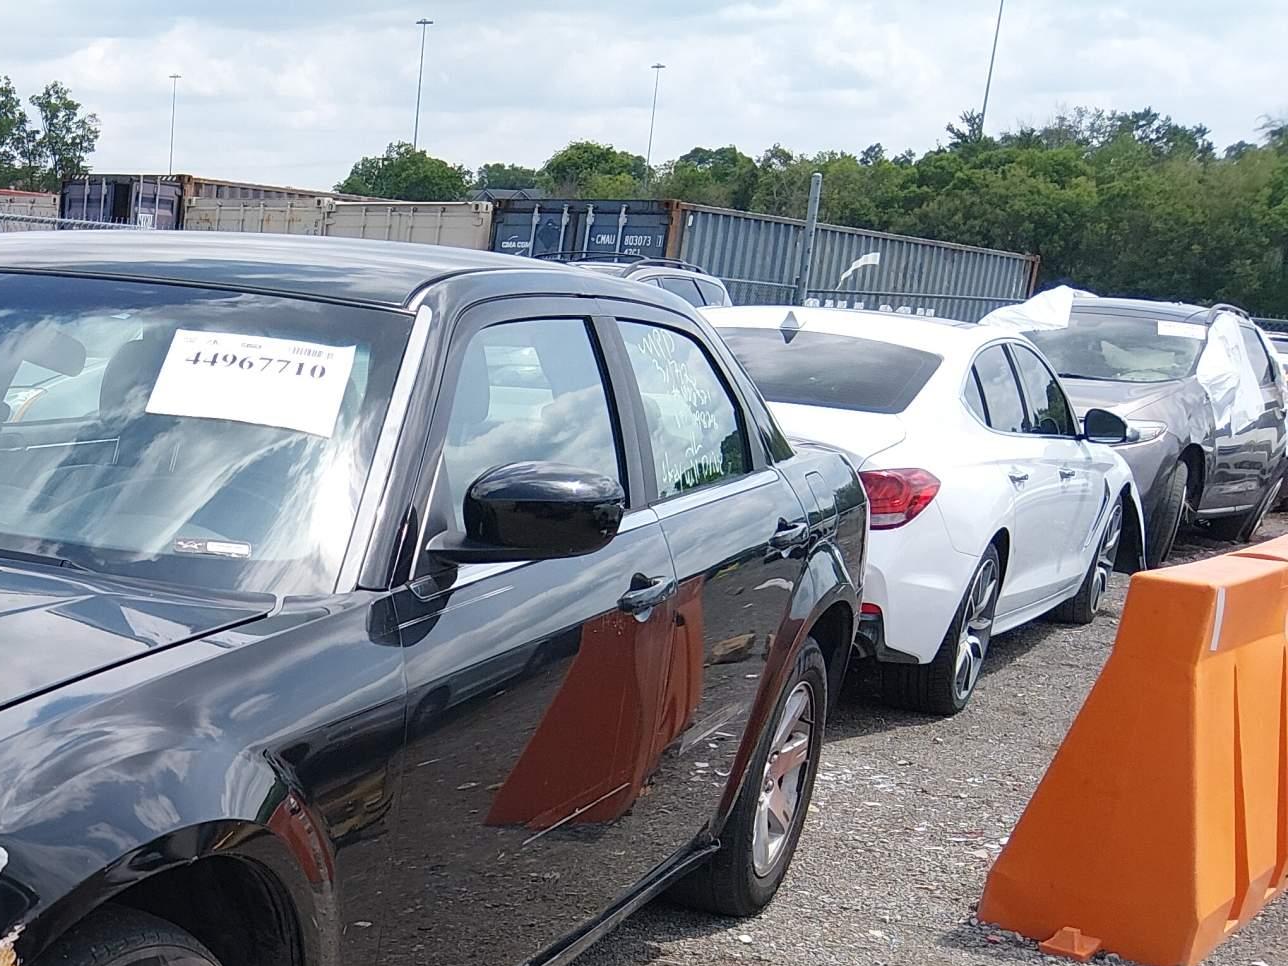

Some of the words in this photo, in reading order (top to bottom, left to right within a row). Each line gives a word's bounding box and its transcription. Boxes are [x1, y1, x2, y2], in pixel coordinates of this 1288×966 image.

[595, 234, 617, 244] CMAU
[623, 235, 652, 247] 803073
[184, 350, 326, 379] 44967710
